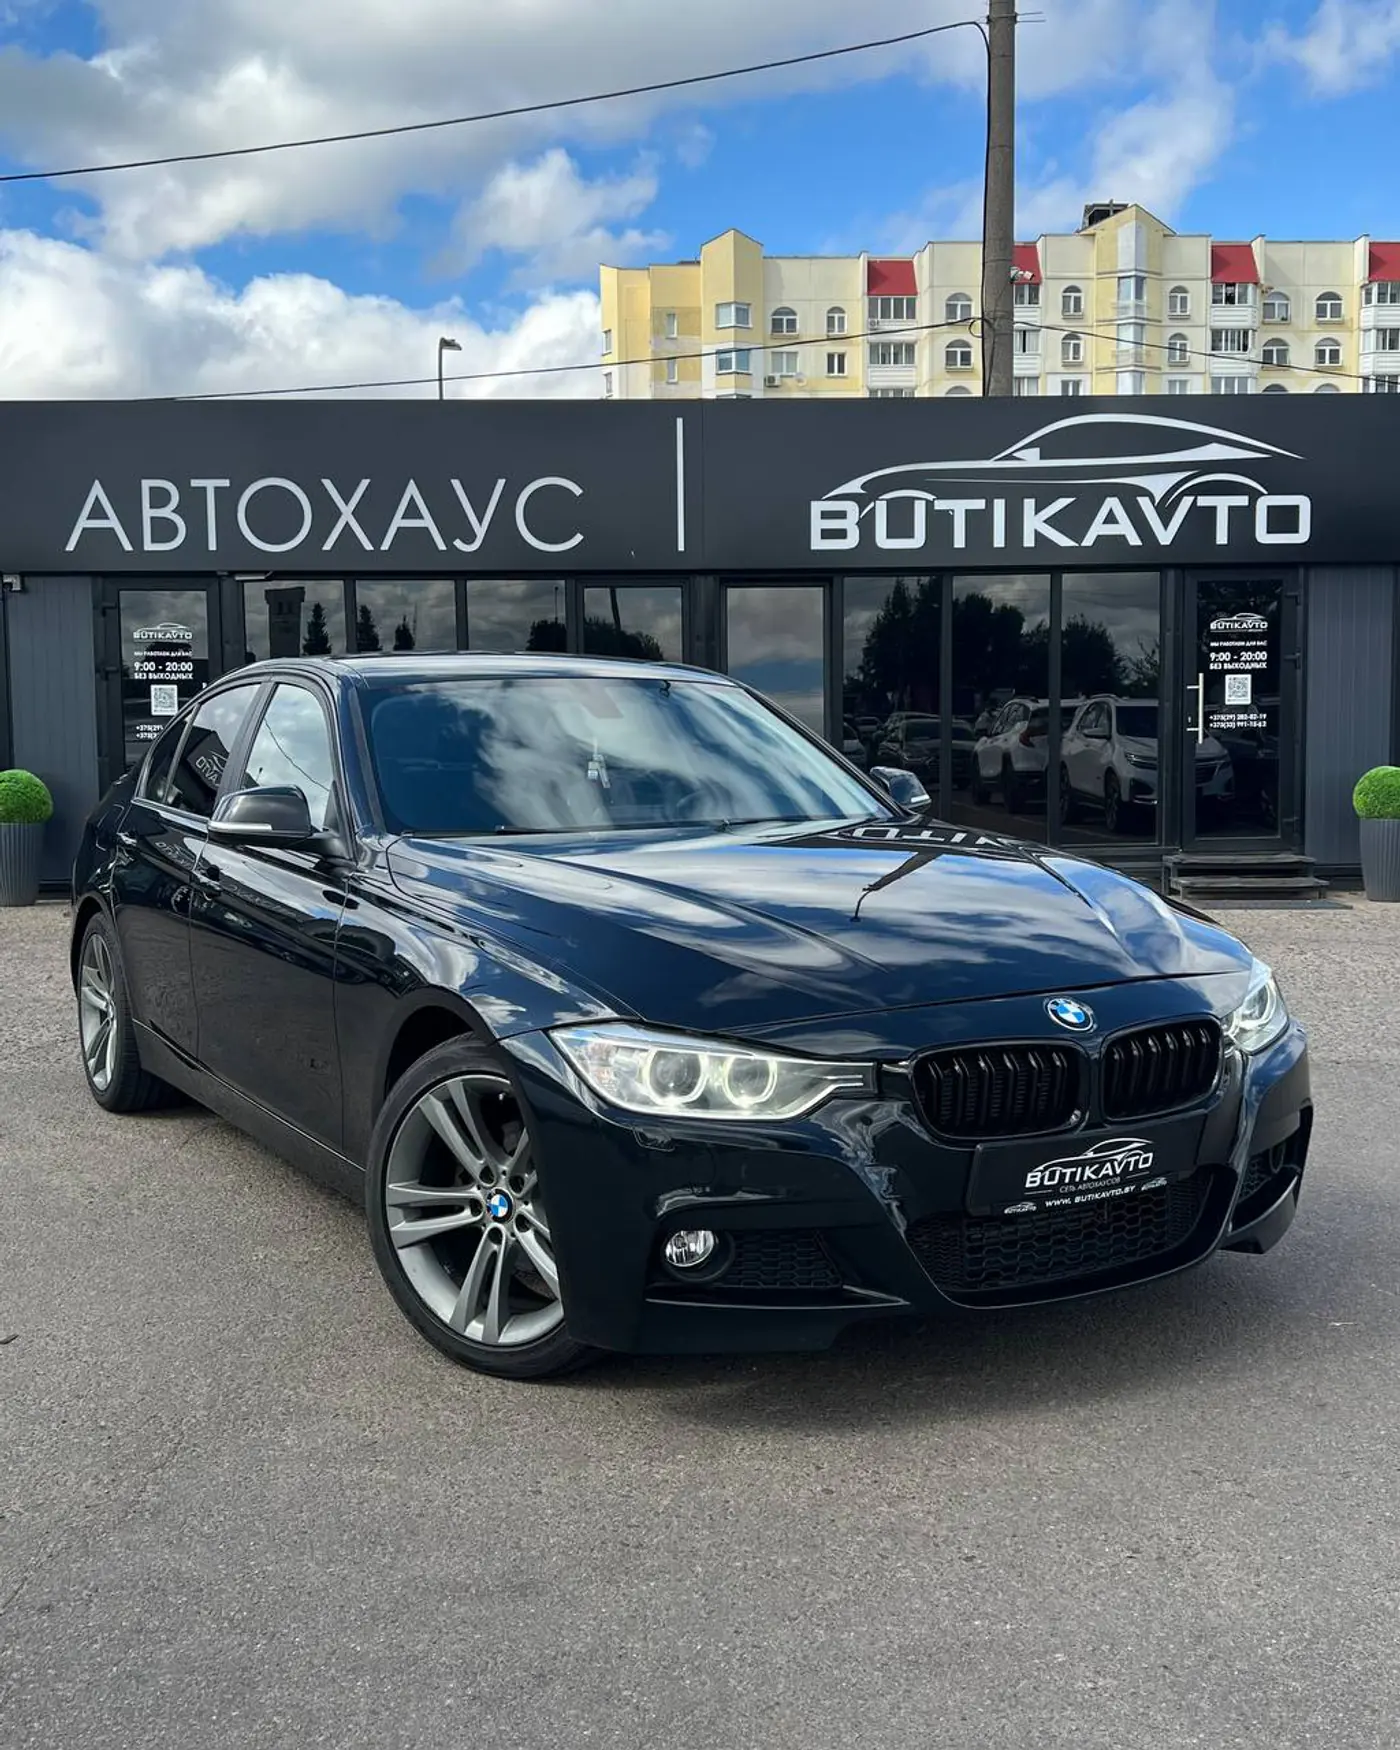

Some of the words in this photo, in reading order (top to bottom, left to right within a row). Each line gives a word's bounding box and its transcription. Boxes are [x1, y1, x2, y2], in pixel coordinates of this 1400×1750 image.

[65, 476, 584, 553] АВТОХАУС
[810, 494, 1311, 550] BUTIKAVTO
[1209, 620, 1268, 630] BUTIKAVTO
[133, 630, 193, 639] BUTIKAVTO
[1209, 651, 1231, 661] 9:00
[1240, 651, 1268, 661] 20:00
[134, 661, 156, 671] 9:00
[165, 661, 193, 671] 20:00
[1209, 662, 1222, 670] БЕЗ
[1223, 661, 1268, 669] ВЫХОДНЫХ
[134, 672, 147, 680] БЕЗ
[148, 672, 194, 680] ВЫХОДНЫХ
[1025, 1152, 1154, 1188] BUTIKAVTO
[1074, 1185, 1136, 1203] BUTIKAVTO.BY
